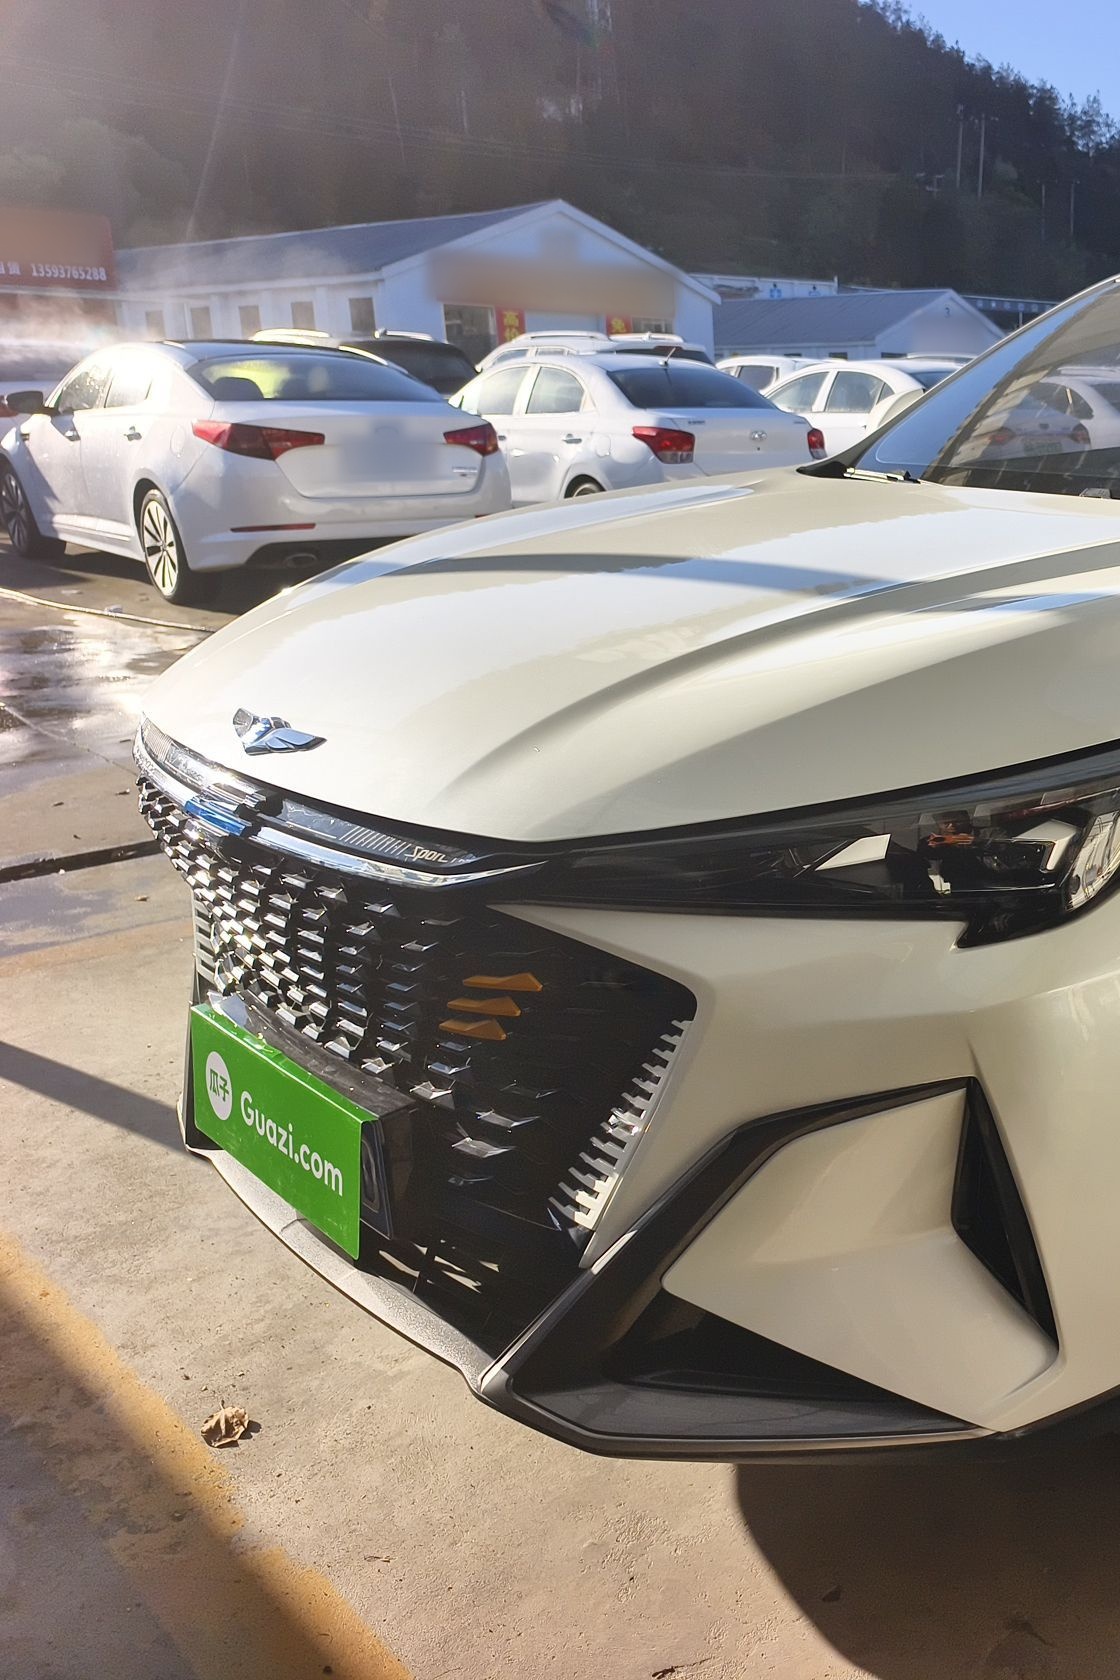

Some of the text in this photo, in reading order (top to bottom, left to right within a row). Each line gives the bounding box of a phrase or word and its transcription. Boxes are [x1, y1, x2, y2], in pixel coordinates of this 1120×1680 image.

[31, 263, 107, 280] 13593765288
[209, 1068, 230, 1103] 瓜子
[240, 1090, 344, 1198] Guazi.com
